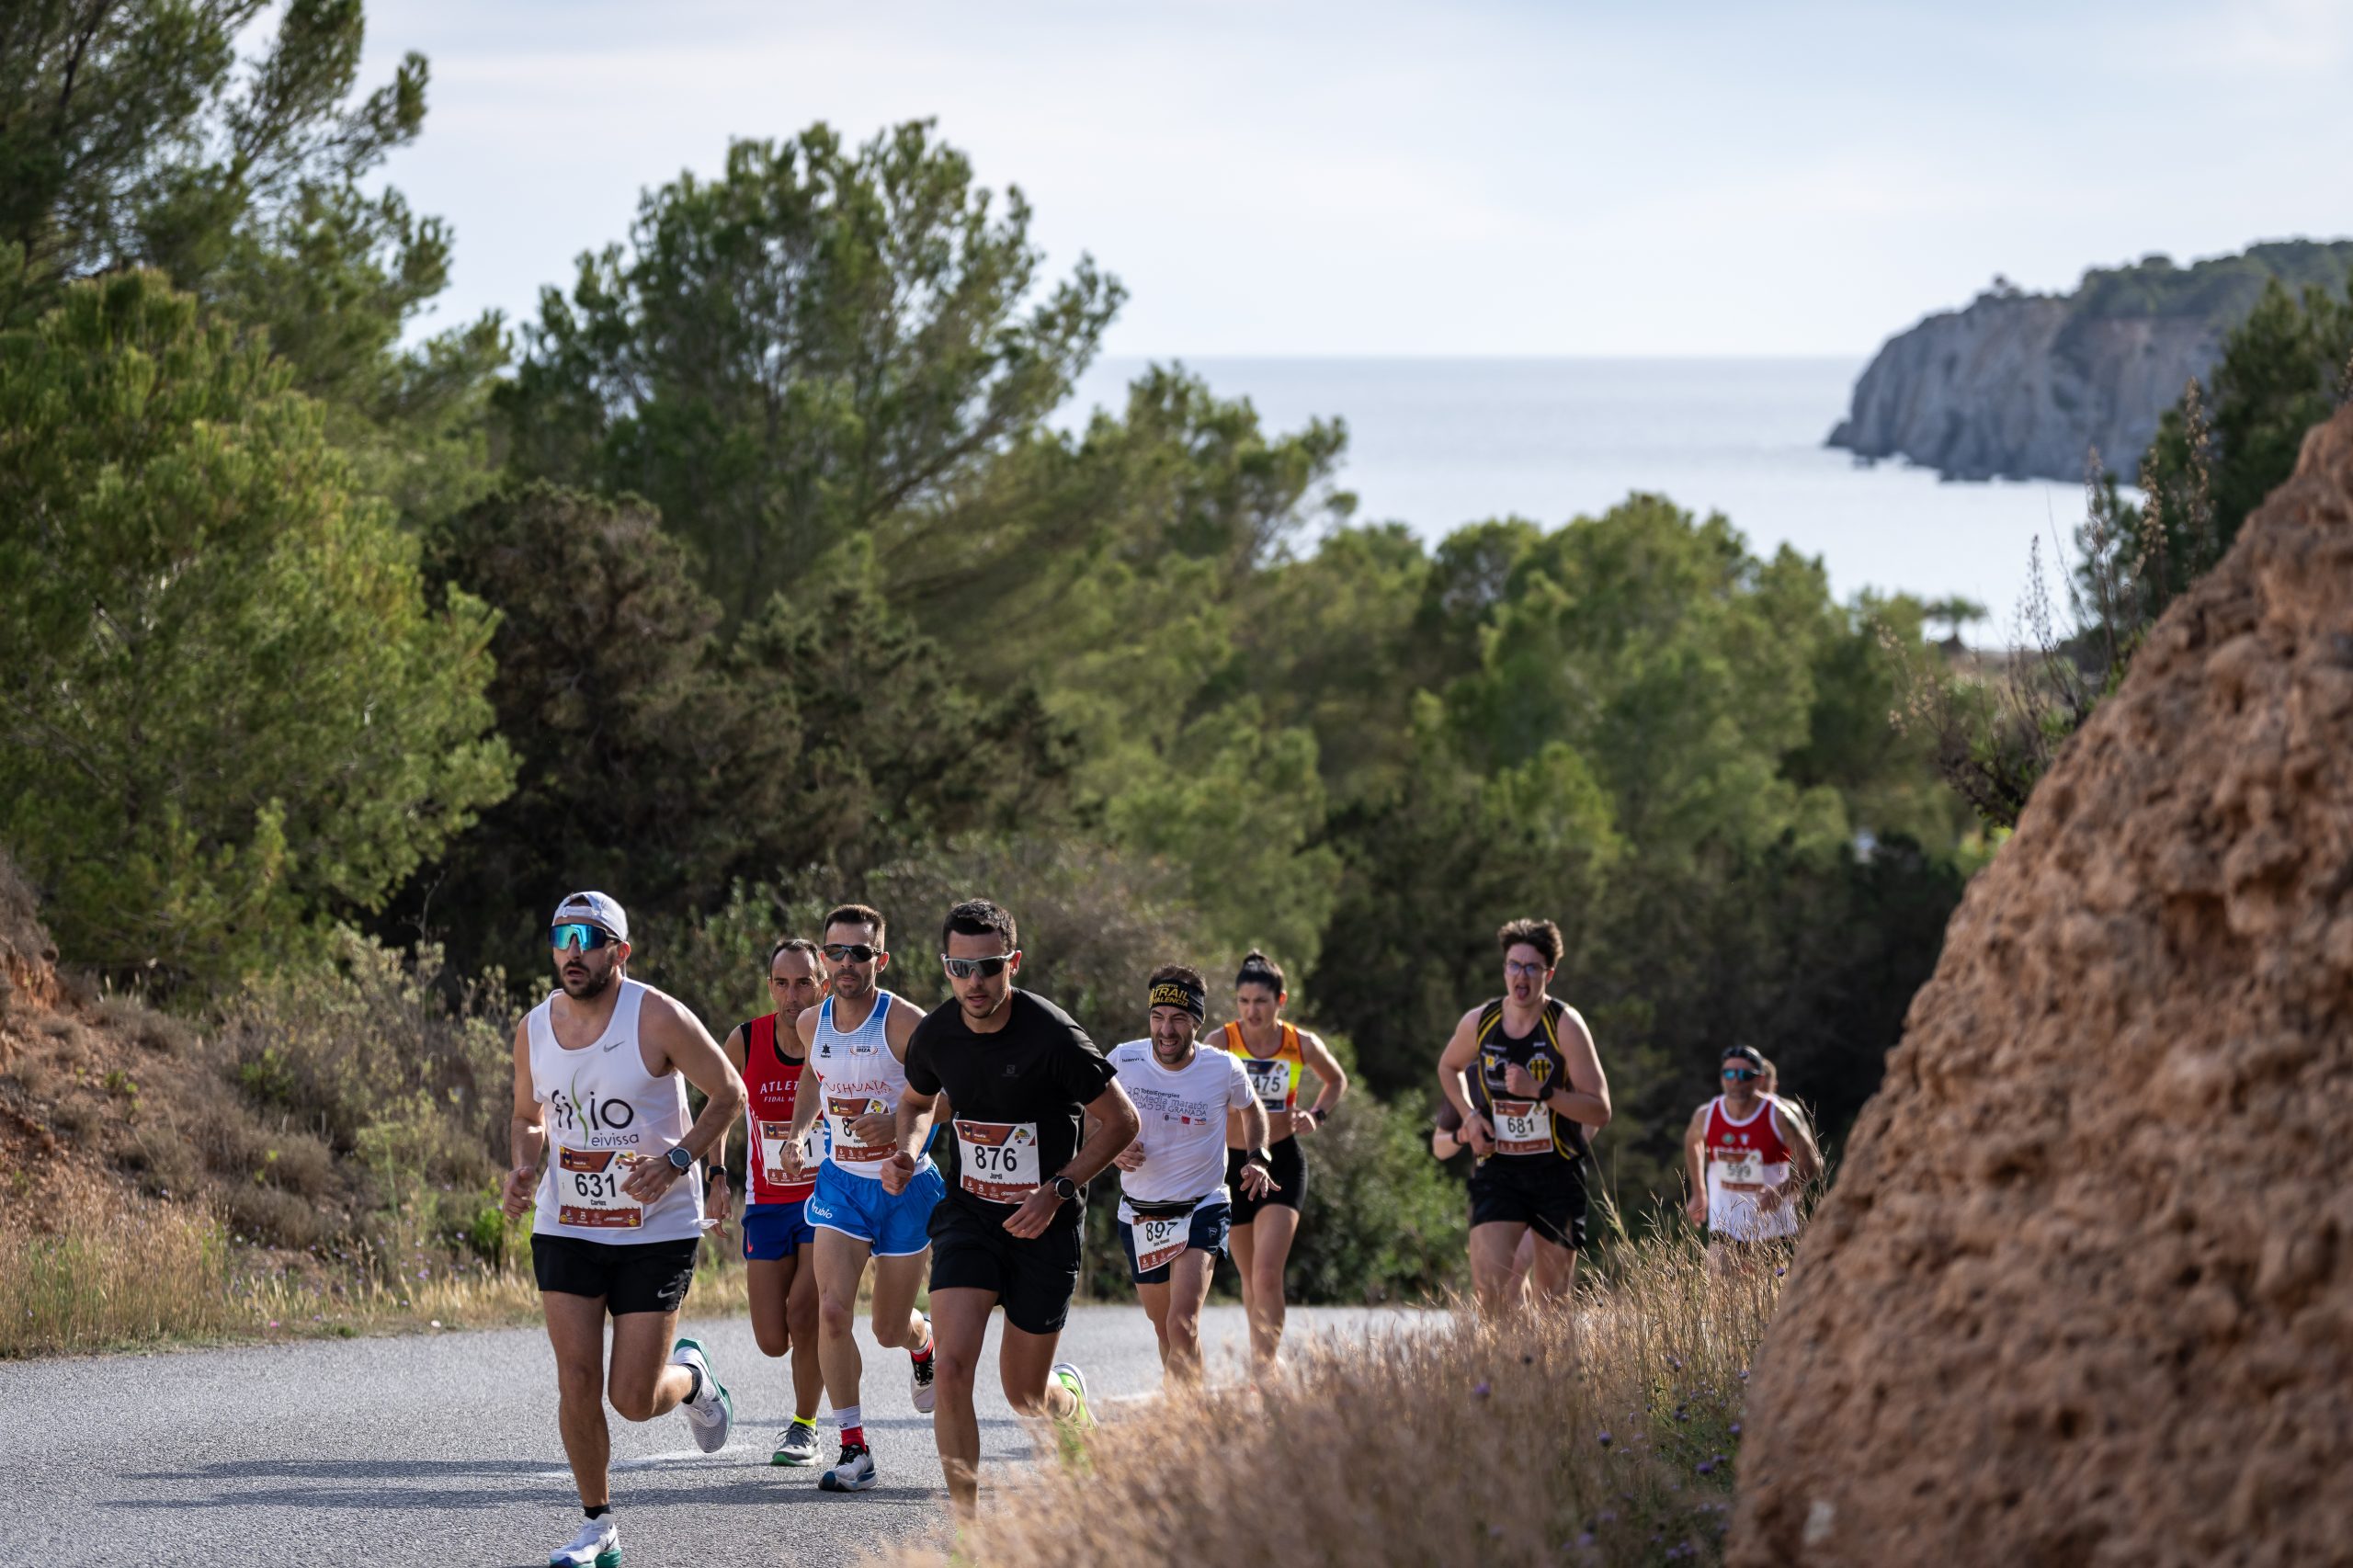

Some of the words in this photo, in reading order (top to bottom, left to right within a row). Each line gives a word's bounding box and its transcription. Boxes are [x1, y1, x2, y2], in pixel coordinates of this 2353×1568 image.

[1152, 996, 1188, 1008] VALENCIA
[1154, 987, 1189, 1002] TRAIL
[760, 1080, 800, 1094] ATLET
[1254, 1076, 1280, 1093] 475
[1141, 1087, 1180, 1099] TotalEnergies
[1168, 1106, 1207, 1117] GRANADA
[1507, 1117, 1534, 1133] 681
[591, 1132, 639, 1147] eivissa
[974, 1145, 1017, 1172] 876
[574, 1173, 616, 1198] 631
[1145, 1221, 1178, 1242] 897
